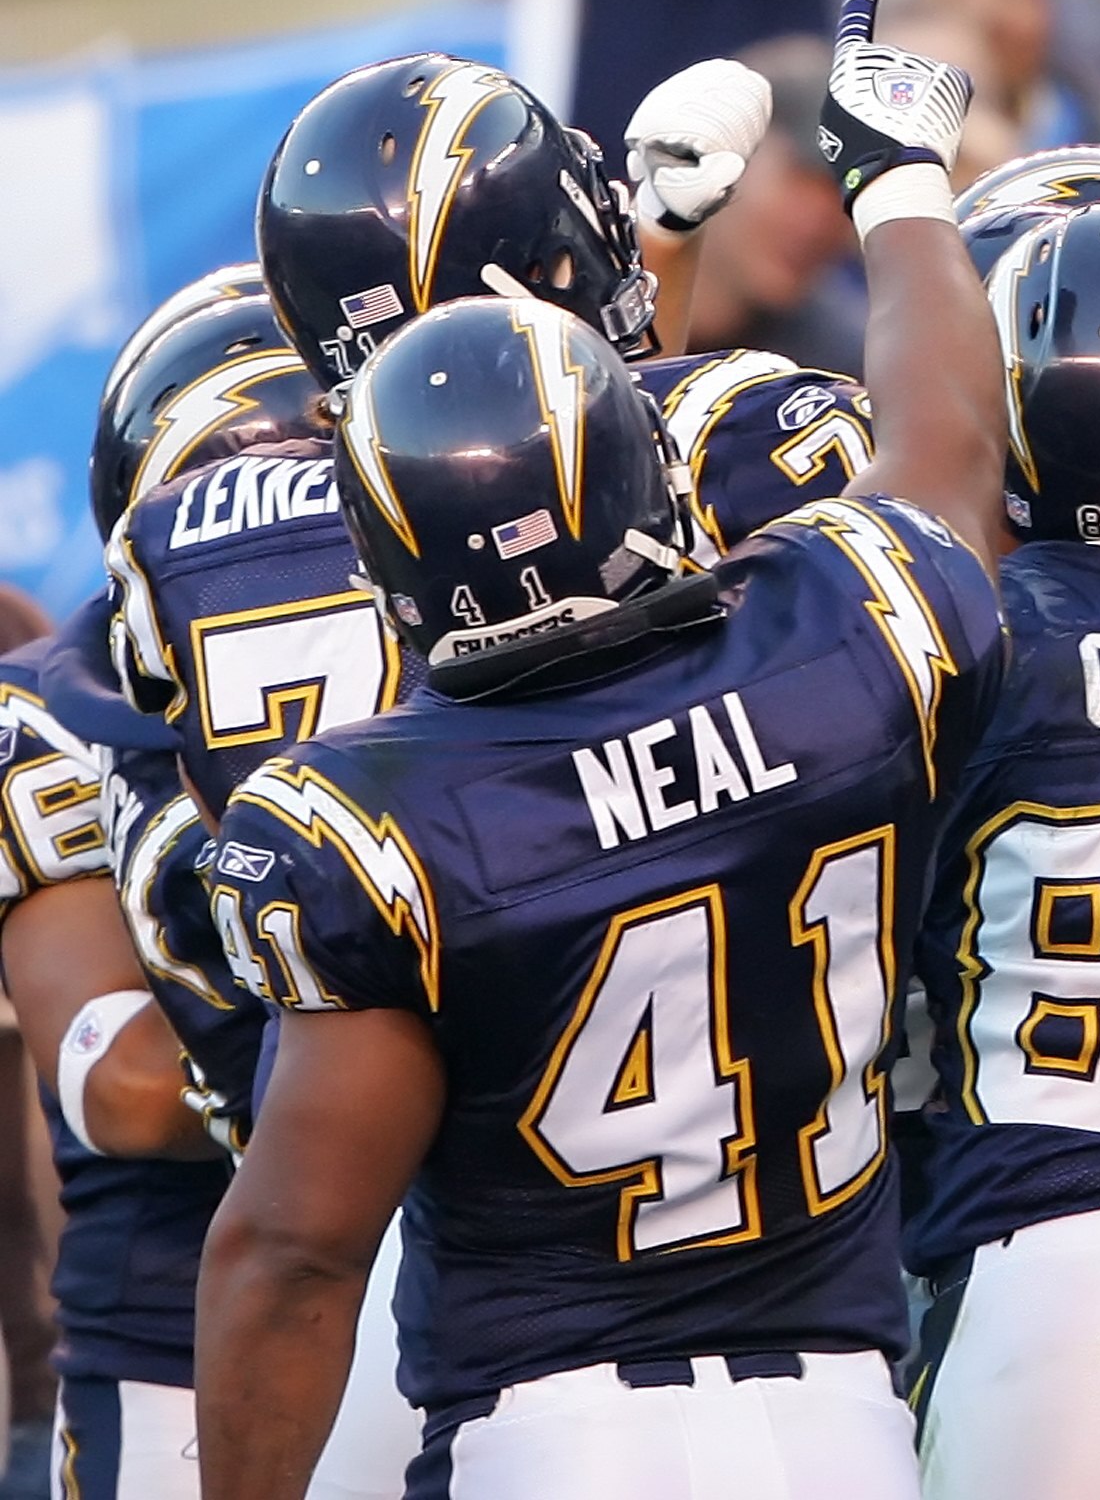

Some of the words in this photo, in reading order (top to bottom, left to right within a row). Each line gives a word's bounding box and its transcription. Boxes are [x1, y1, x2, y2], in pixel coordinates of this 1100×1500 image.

[768, 390, 877, 486] 7
[0, 751, 115, 900] 6
[572, 692, 798, 850] NEAL
[210, 883, 349, 1012] 41
[517, 823, 896, 1263] 41
